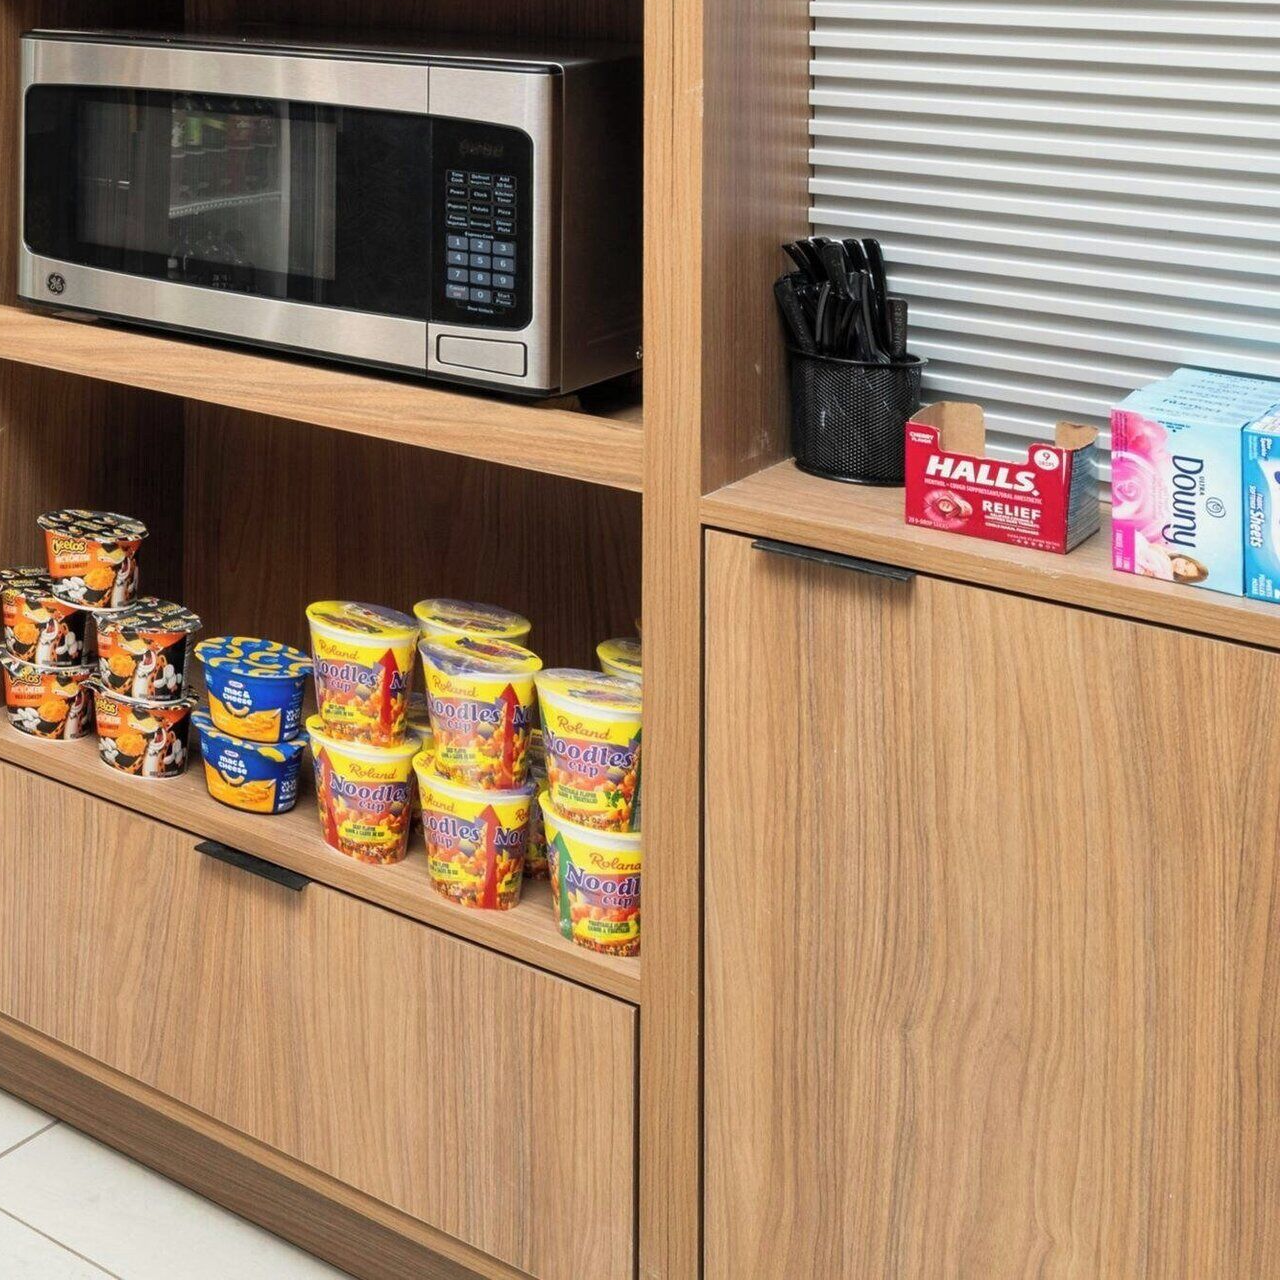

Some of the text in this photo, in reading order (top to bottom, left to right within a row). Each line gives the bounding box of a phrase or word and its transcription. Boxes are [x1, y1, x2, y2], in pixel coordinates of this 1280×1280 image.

[909, 431, 934, 441] CHERRY
[1042, 452, 1051, 462] 9
[1162, 455, 1204, 548] Downy
[982, 500, 1041, 520] RELIEF
[52, 539, 86, 553] Cheetos
[318, 638, 360, 660] Roland
[224, 686, 243, 697] mac
[330, 679, 351, 693] cup
[432, 674, 477, 698] Roland
[222, 693, 252, 705] cheese
[446, 717, 471, 734] cup
[556, 715, 612, 741] Roland
[218, 761, 247, 775] cheese
[219, 755, 239, 767] mac
[348, 762, 398, 781] Roland
[568, 760, 600, 779] cup
[329, 770, 410, 802] Noodles
[358, 799, 385, 813] cup
[601, 893, 632, 908] cup
